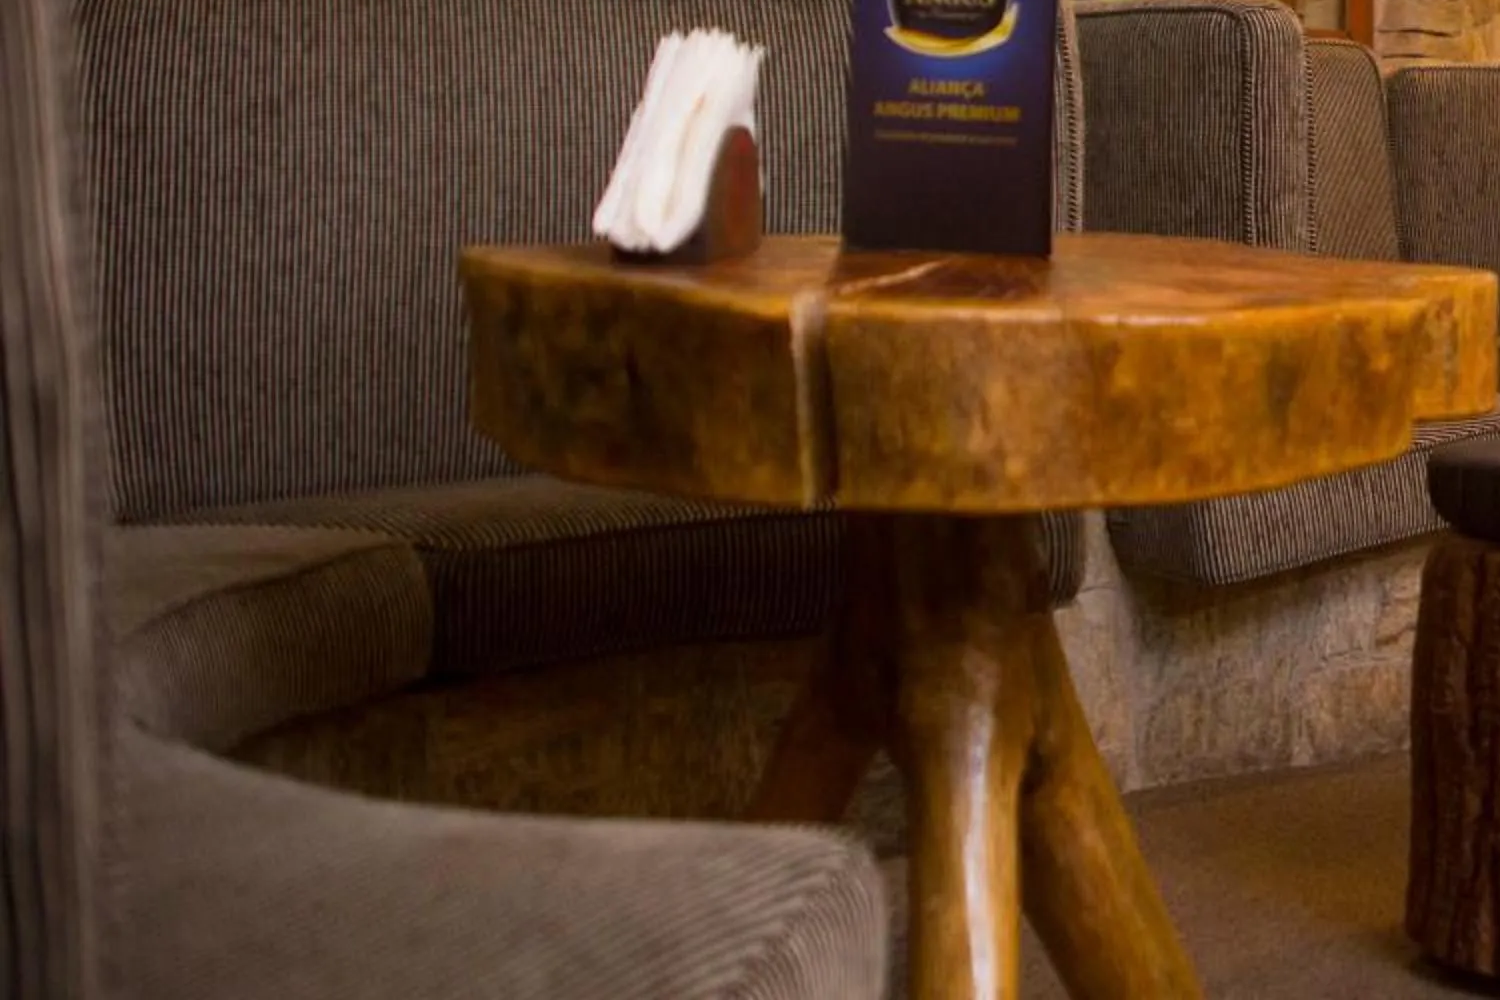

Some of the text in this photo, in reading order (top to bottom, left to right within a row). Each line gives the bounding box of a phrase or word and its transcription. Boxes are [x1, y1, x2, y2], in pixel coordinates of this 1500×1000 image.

[909, 78, 984, 99] ALIANÇA
[874, 101, 1020, 121] ANGUS PREMIUM
